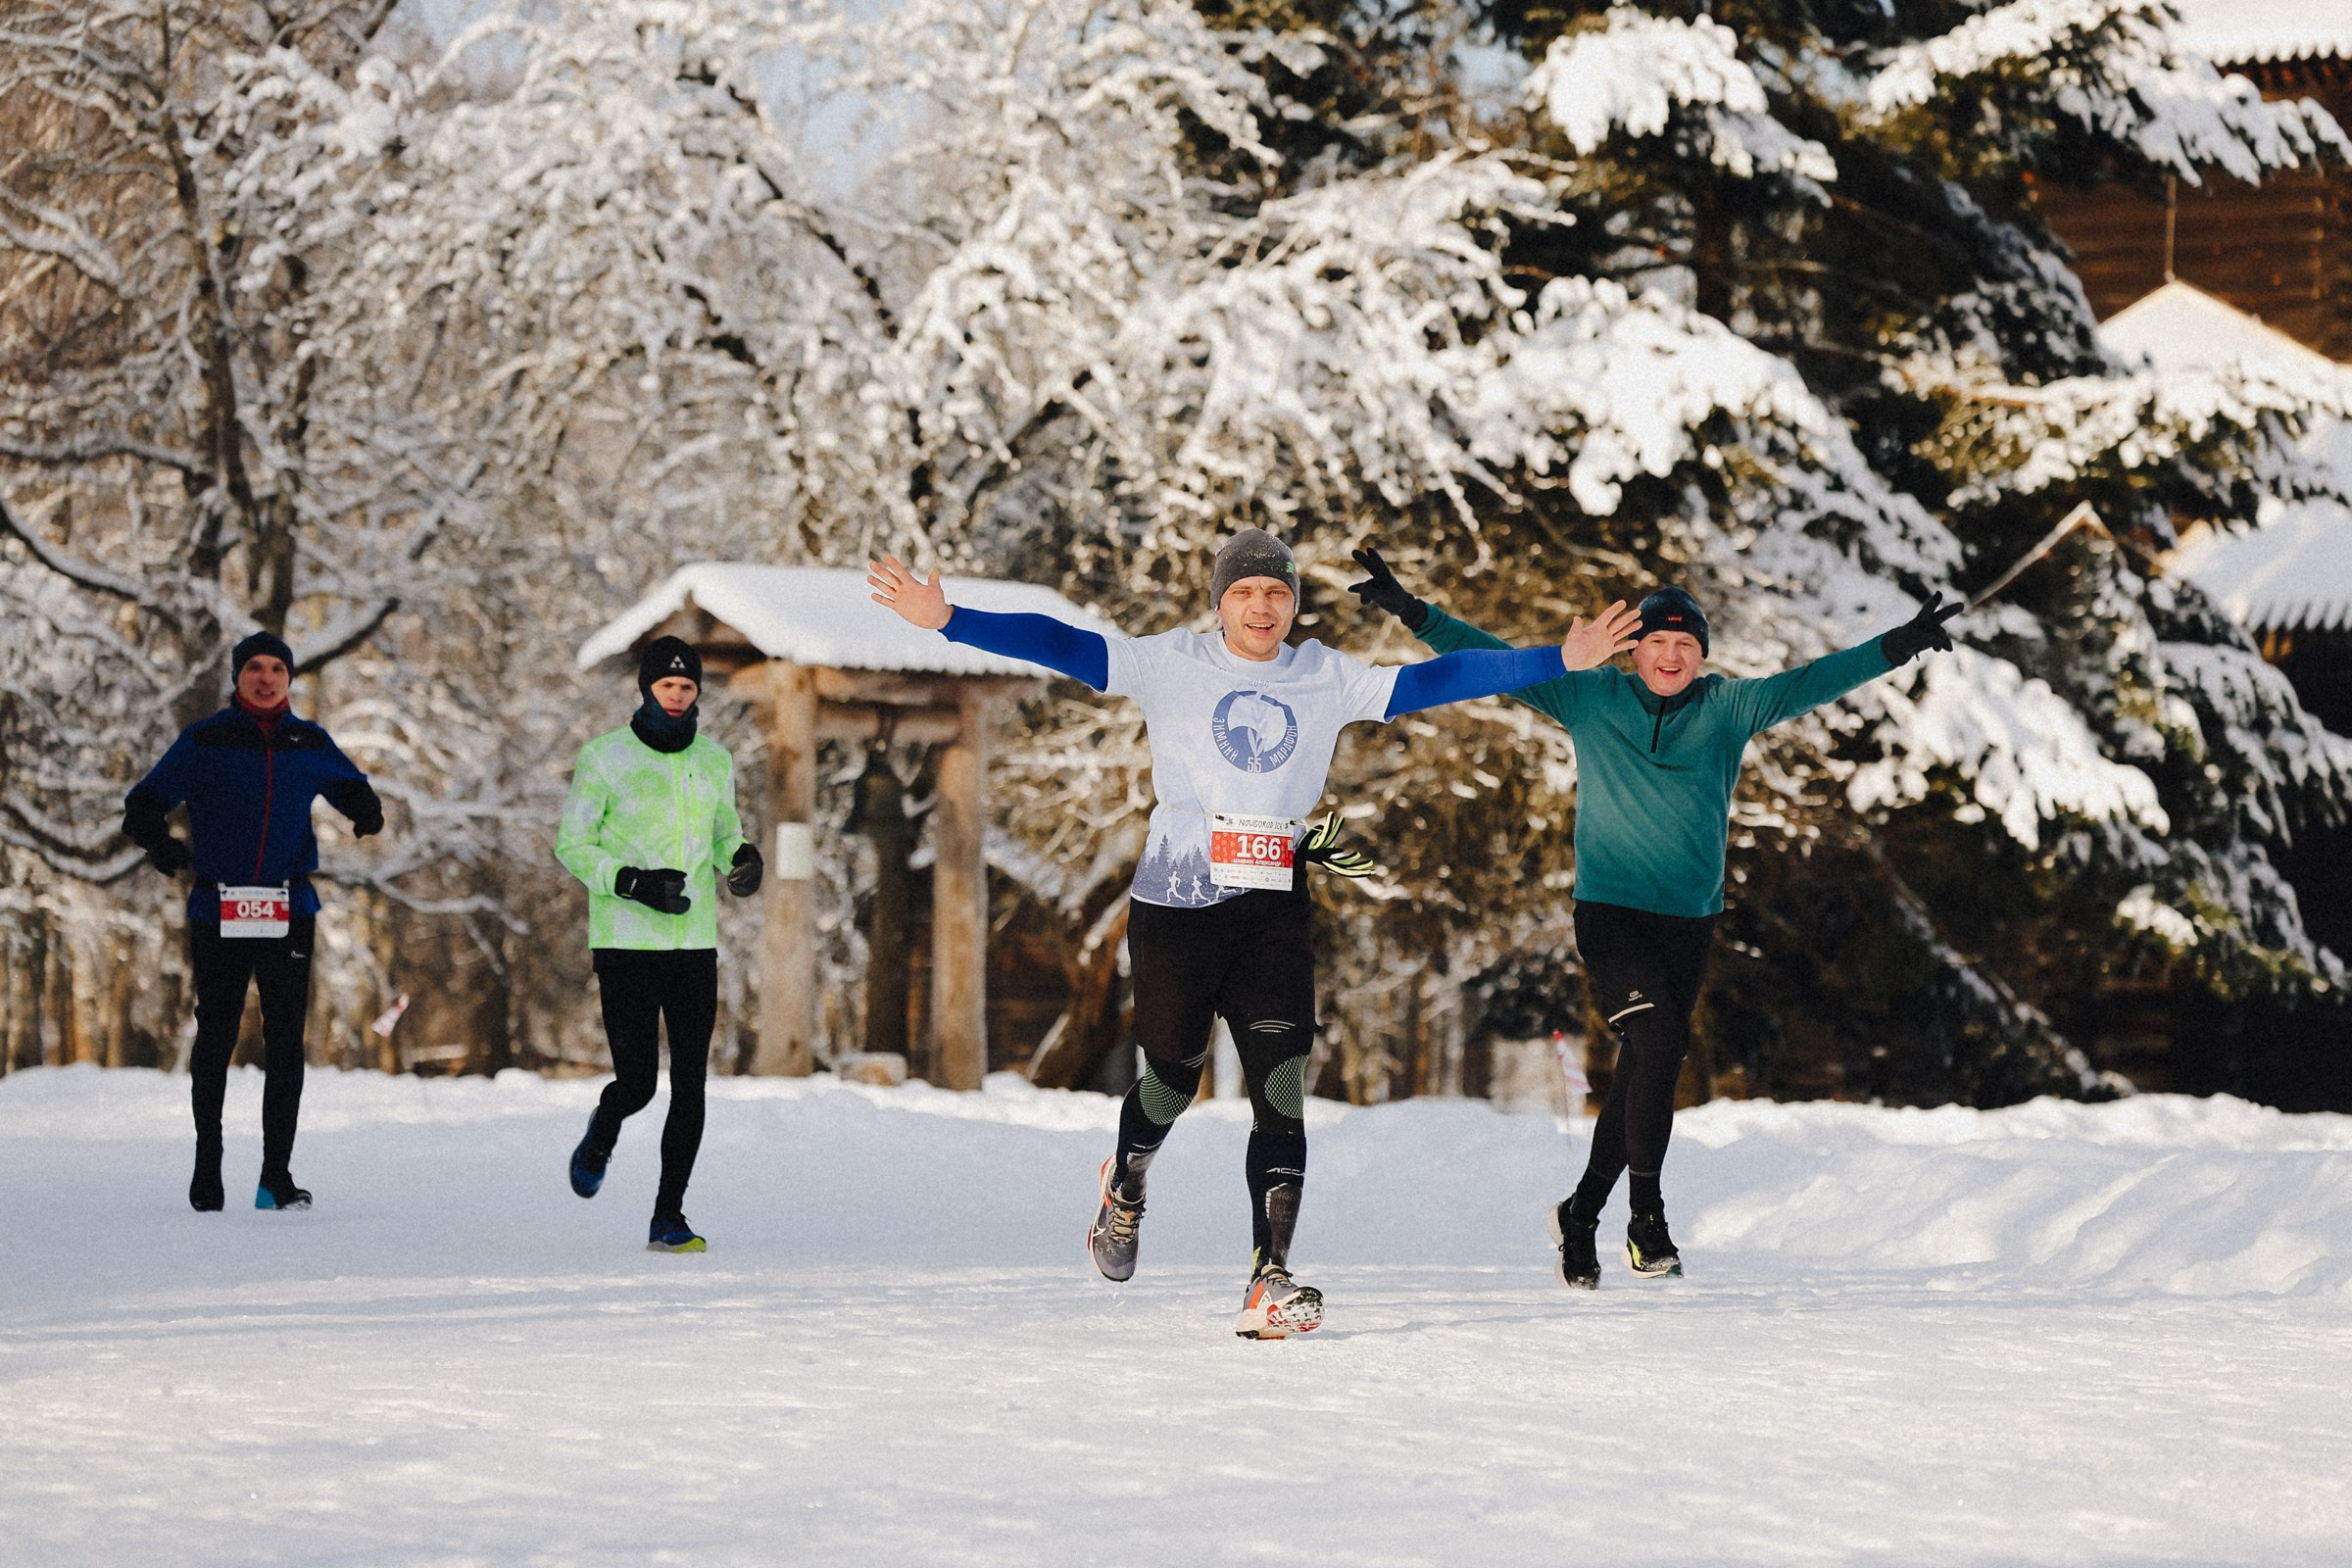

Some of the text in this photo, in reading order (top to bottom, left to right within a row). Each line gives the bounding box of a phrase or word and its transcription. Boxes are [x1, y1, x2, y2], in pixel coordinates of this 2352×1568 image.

[1212, 717, 1239, 762] ЗИМНИЙ
[1269, 725, 1298, 766] МАРАФОН
[1247, 757, 1262, 773] 55
[1236, 835, 1281, 860] 166
[237, 901, 275, 918] 054
